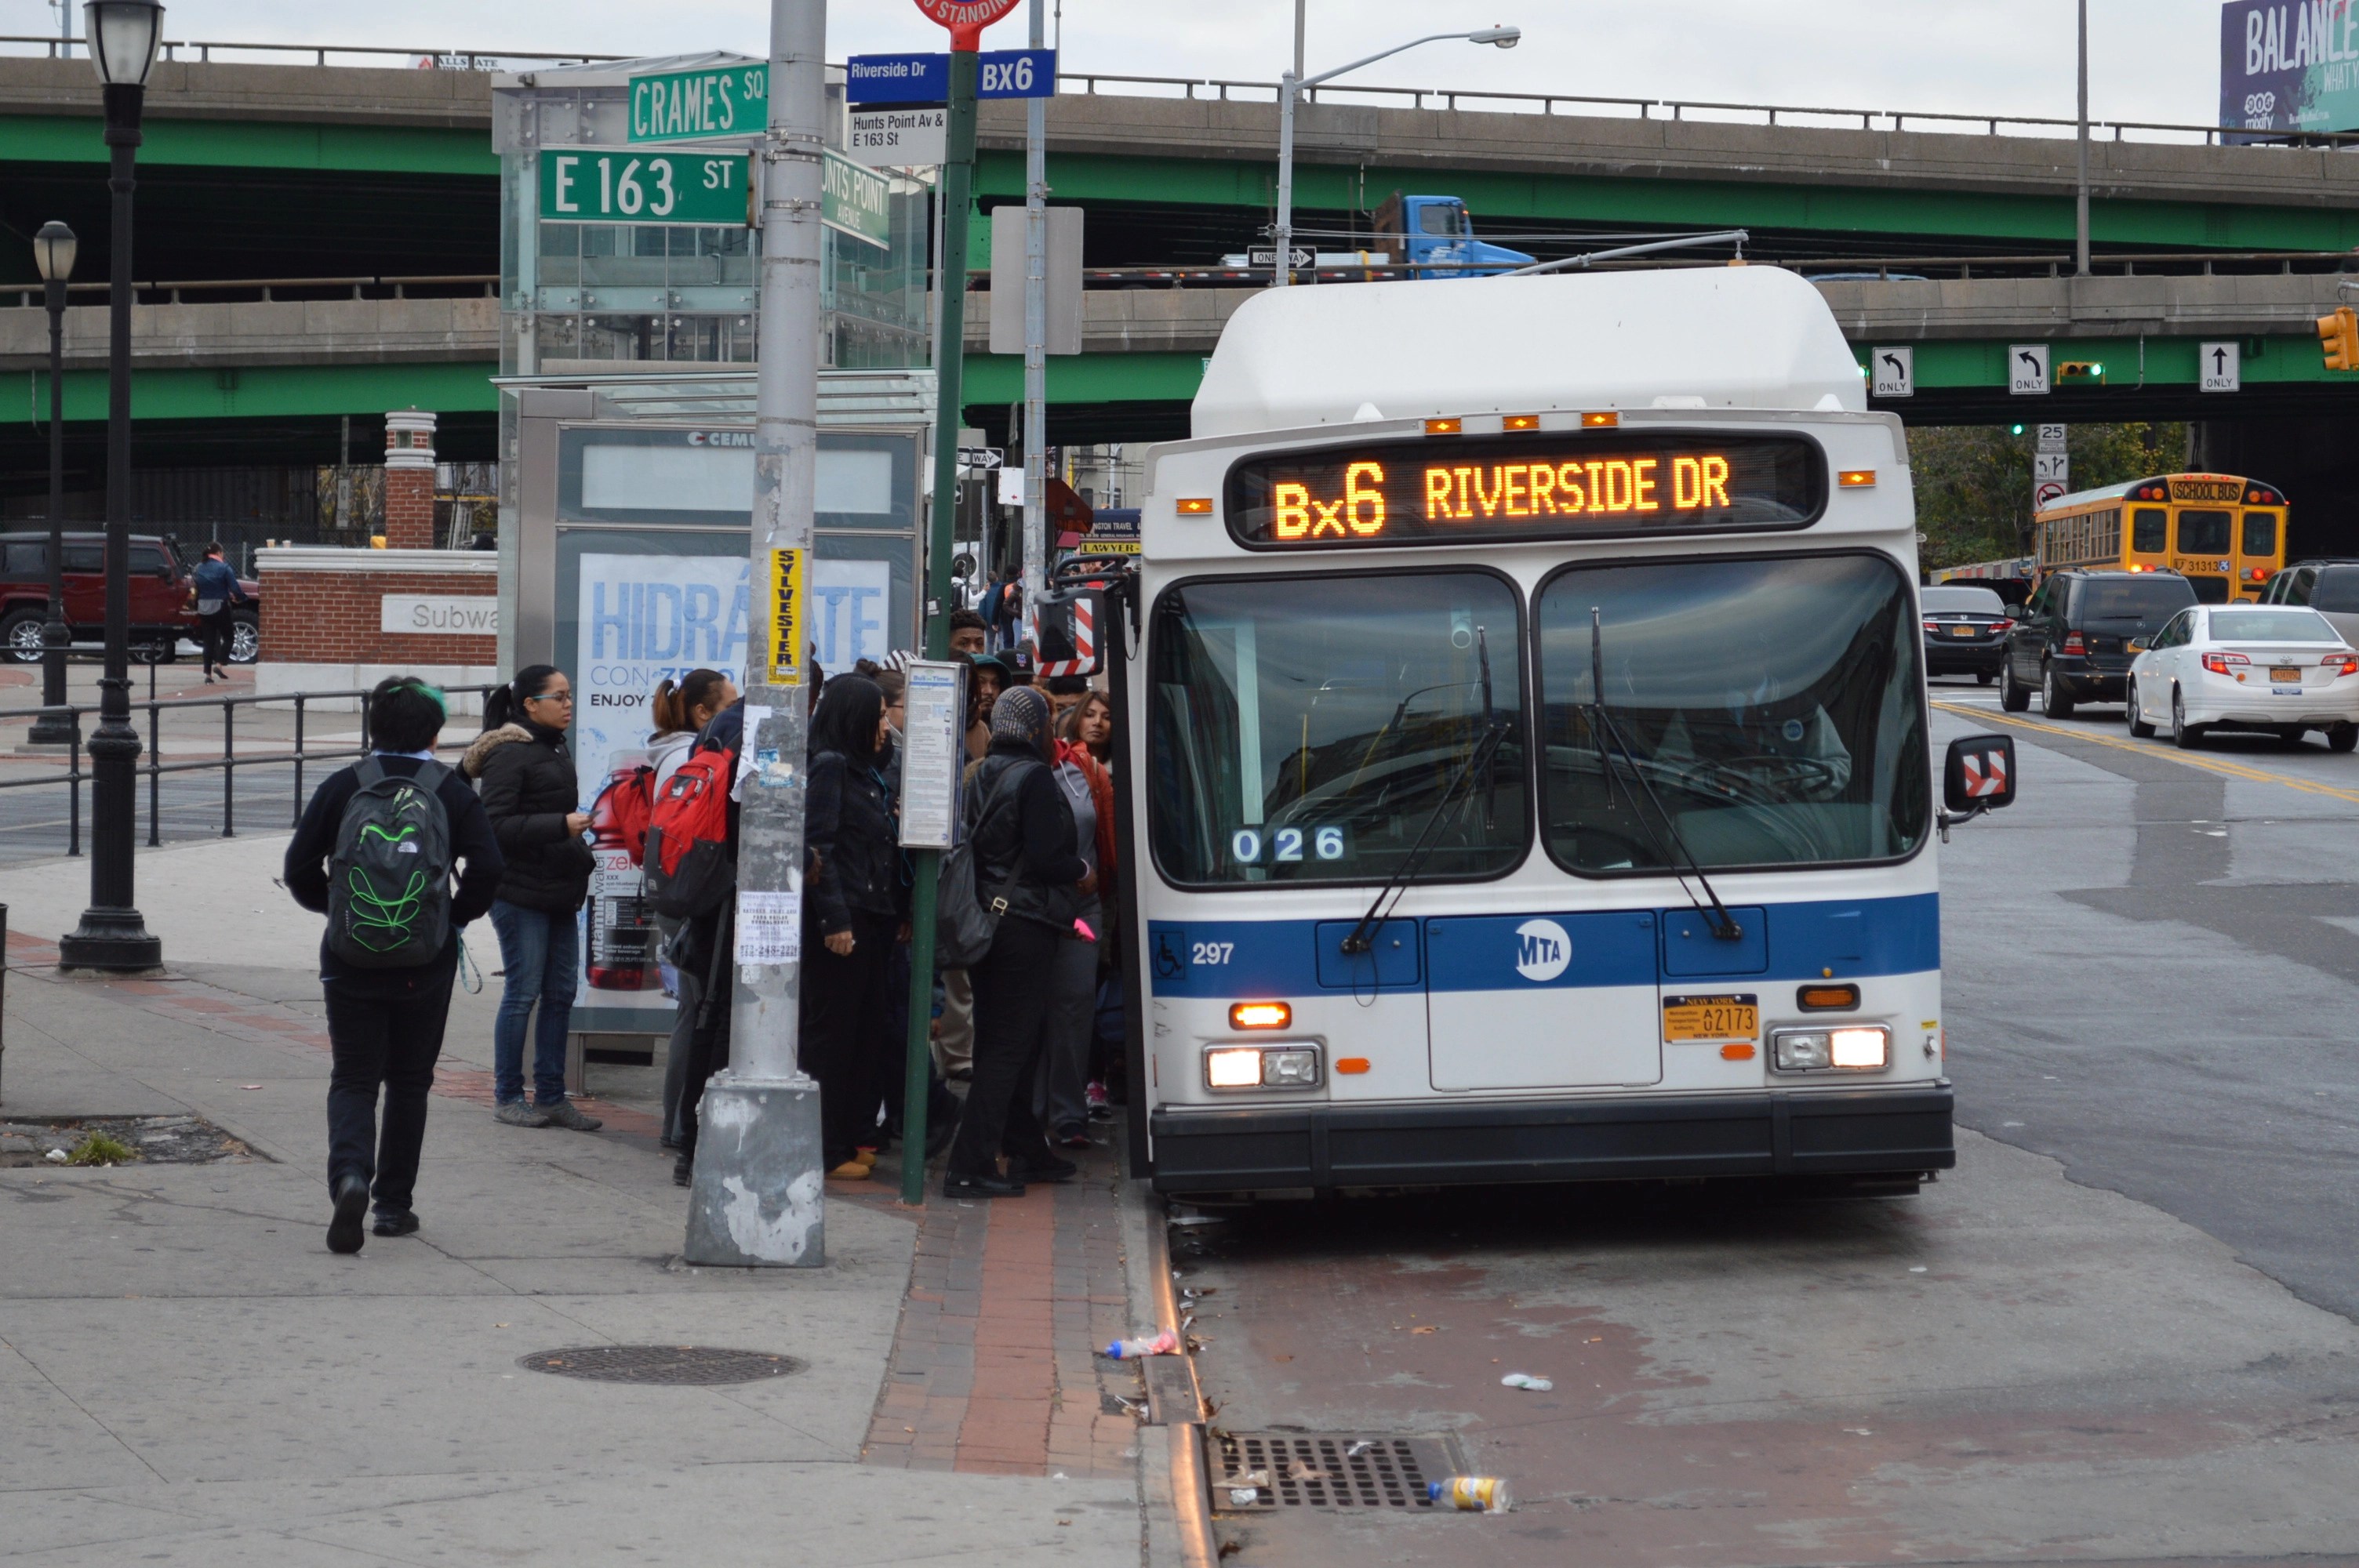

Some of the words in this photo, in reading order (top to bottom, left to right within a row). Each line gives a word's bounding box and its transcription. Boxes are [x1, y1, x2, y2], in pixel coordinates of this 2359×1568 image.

[937, 0, 1008, 24] STANDIN
[2245, 0, 2359, 75] BALANCE
[438, 58, 499, 67] ALLSATE
[852, 63, 908, 78] Riverside
[911, 62, 926, 77] Dr
[982, 57, 1034, 91] BX6
[2324, 63, 2351, 93] WHAT
[634, 75, 734, 136] CRAMES
[743, 71, 764, 100] SQ
[853, 116, 884, 130] Hunts
[888, 115, 915, 129] Point
[918, 114, 932, 127] Av
[935, 113, 943, 126] &
[2245, 114, 2276, 129] mixify
[853, 133, 860, 147] E
[863, 132, 883, 147] 163
[887, 132, 899, 146] St
[555, 157, 579, 212] E
[598, 158, 674, 216] 163
[703, 161, 734, 189] ST
[821, 156, 849, 201] UNTS
[853, 170, 885, 216] POINT
[837, 205, 860, 230] AVENUE
[1258, 253, 1277, 263] ONE
[1879, 383, 1906, 391] ONLY
[2016, 380, 2043, 389] ONLY
[2207, 379, 2233, 387] ONLY
[709, 432, 755, 446] CEMU
[2042, 426, 2063, 438] 25
[1275, 463, 1385, 538] Bx6
[1427, 460, 1659, 519] RIVERSIDE
[1673, 456, 1730, 510] DR
[2176, 483, 2216, 499] SCHOOL
[2218, 484, 2239, 500] BUS
[2189, 561, 2219, 572] 31313
[413, 604, 498, 628] Subwa
[776, 550, 794, 665] SYLVESTER
[591, 666, 649, 686] CON
[591, 694, 645, 706] ENJOY
[606, 855, 645, 871] zer
[1192, 942, 1234, 964] 297
[1516, 932, 1561, 967] MTA
[1715, 1008, 1754, 1031] 2173
